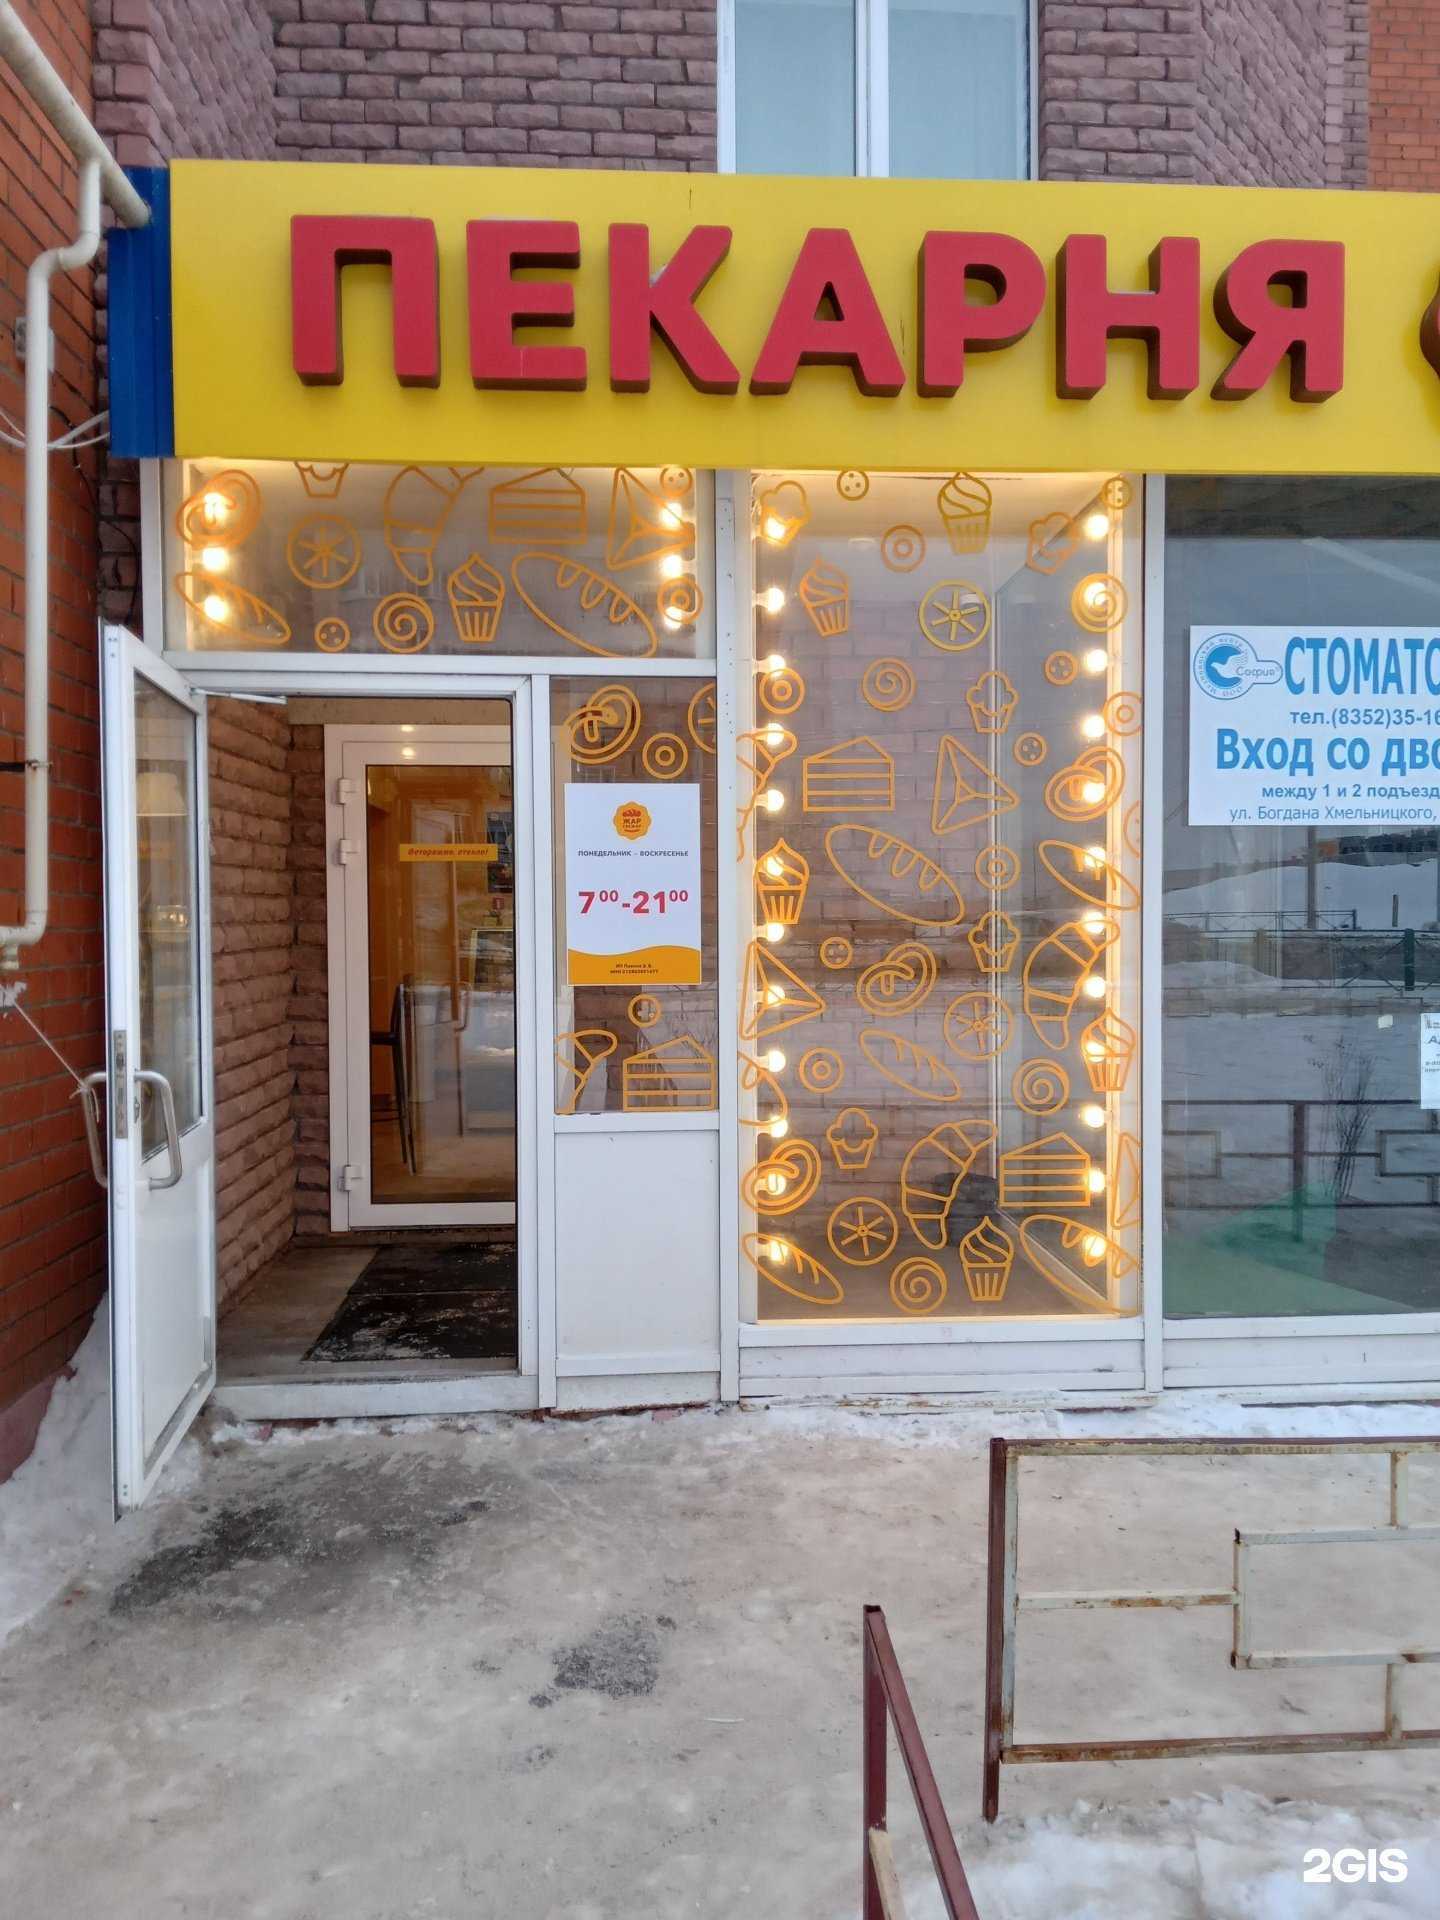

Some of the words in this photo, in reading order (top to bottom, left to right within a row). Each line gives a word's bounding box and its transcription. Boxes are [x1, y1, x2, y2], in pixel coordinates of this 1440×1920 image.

[290, 214, 1345, 403] ПЕКАРНЯ
[1216, 728, 1314, 776] Вход
[1327, 737, 1370, 770] со
[1262, 787, 1317, 799] между
[1323, 784, 1330, 797] 1
[1337, 787, 1347, 797] и
[1352, 784, 1361, 797] 2
[1367, 787, 1440, 799] подъезд
[1230, 808, 1251, 822] ул.
[1258, 806, 1319, 821] Богдана
[1325, 806, 1437, 822] Хмельницкого,
